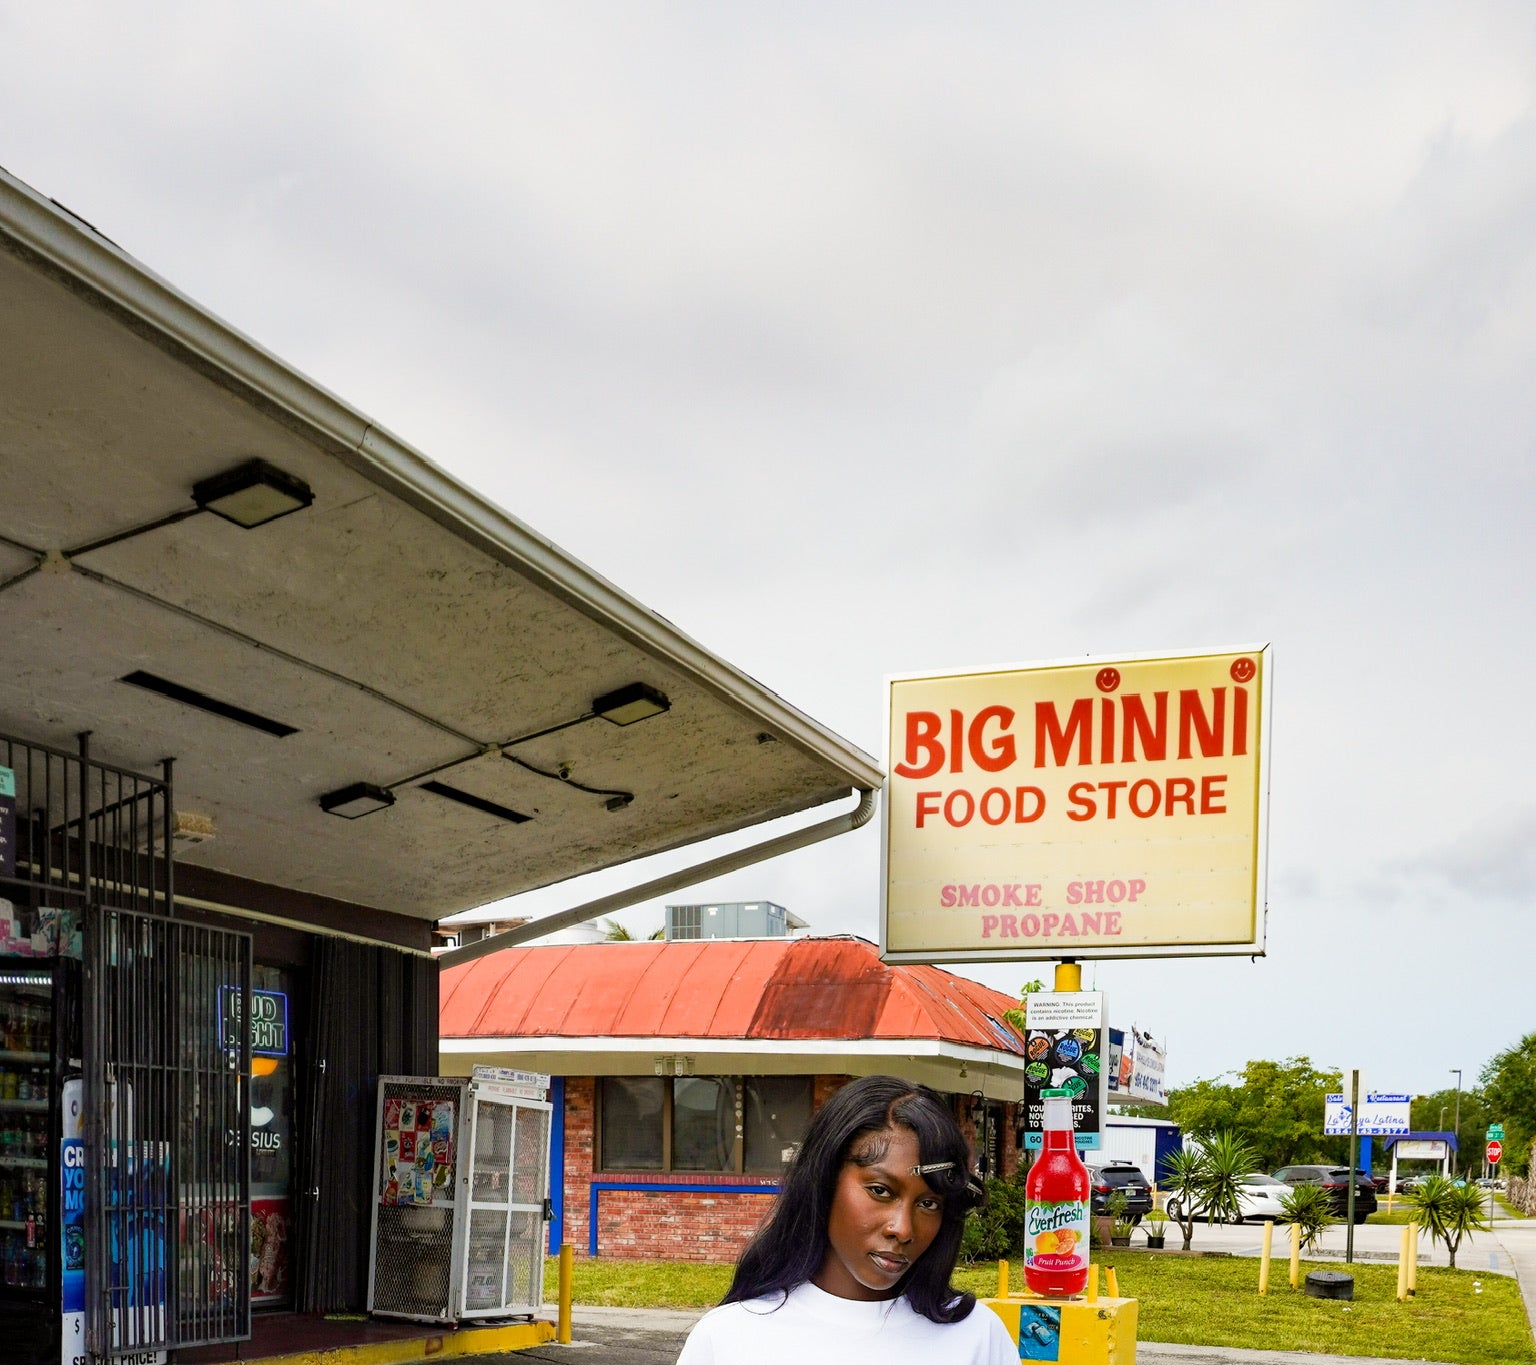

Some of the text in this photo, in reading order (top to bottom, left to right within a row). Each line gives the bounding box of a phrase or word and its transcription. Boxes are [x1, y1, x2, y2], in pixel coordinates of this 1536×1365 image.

[893, 705, 1017, 779] BIG
[915, 775, 1228, 828] FOOD STORE
[940, 878, 1146, 907] SMOKE SHOP
[982, 911, 1122, 938] PROPANE
[1059, 1042, 1077, 1054] ROGUE
[1327, 1115, 1338, 1125] La
[1373, 1114, 1405, 1125] Latina
[1487, 1148, 1501, 1156] STOP
[1029, 1202, 1083, 1235] Everfresh
[74, 1317, 80, 1335] $
